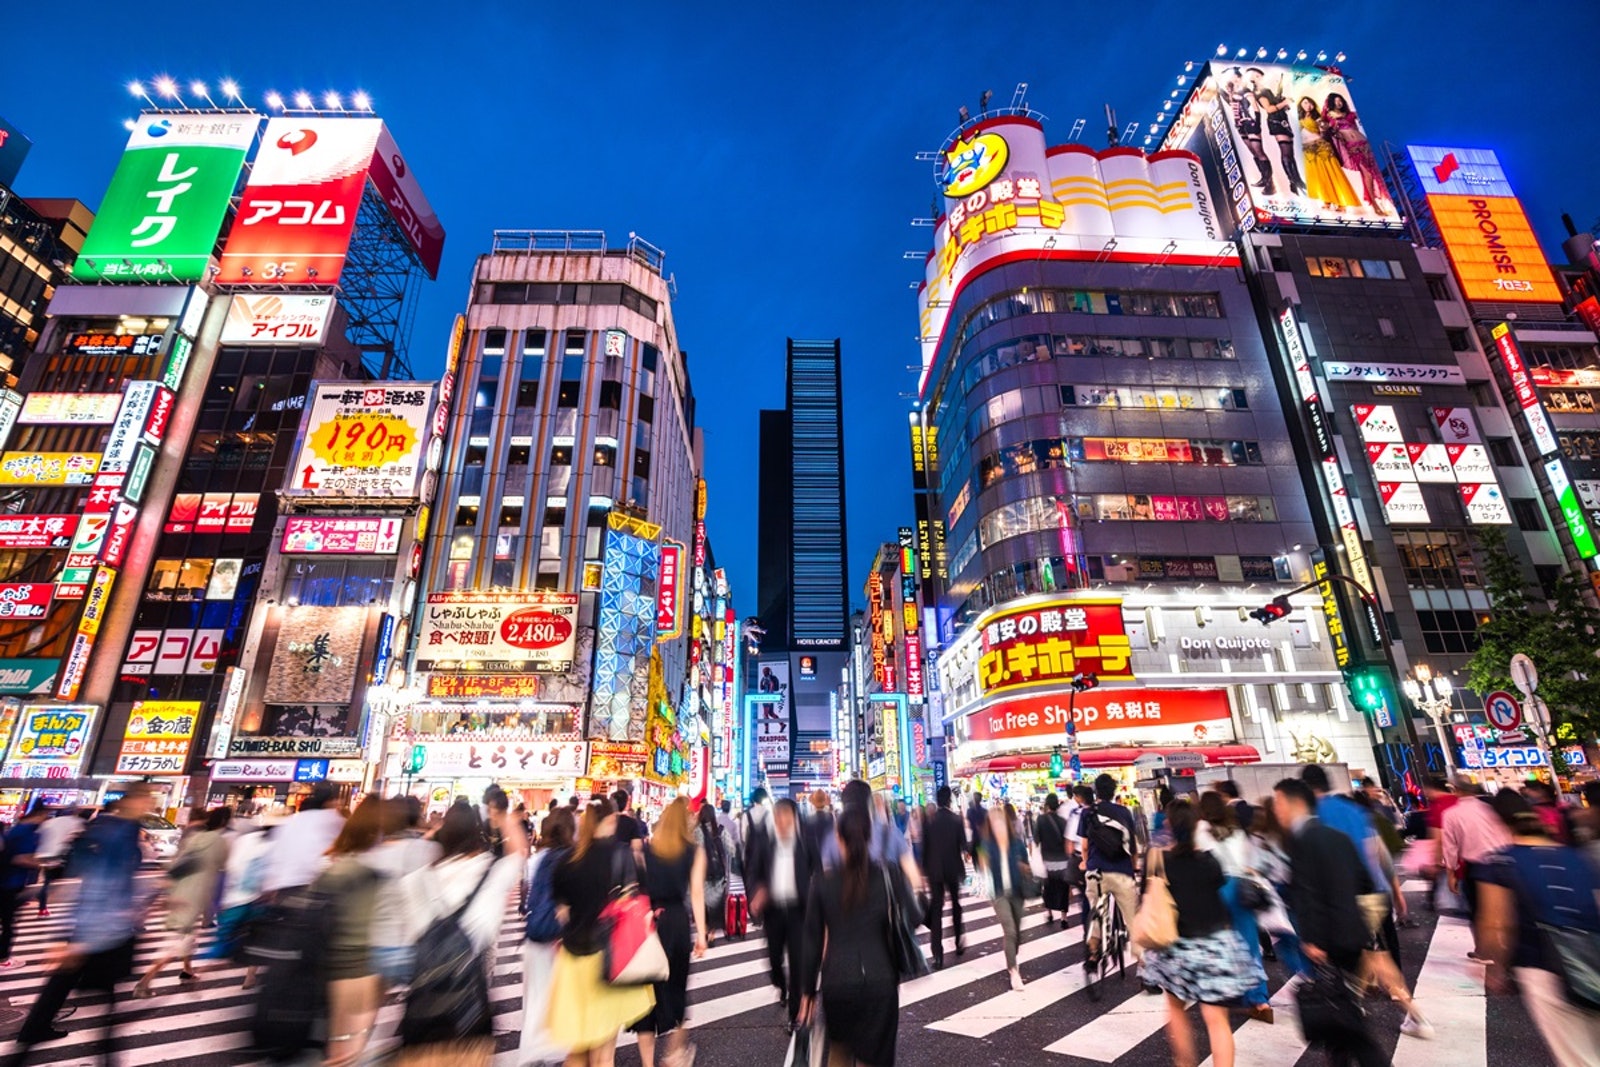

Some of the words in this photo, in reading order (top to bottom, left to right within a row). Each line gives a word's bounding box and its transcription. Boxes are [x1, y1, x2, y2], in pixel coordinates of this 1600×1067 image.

[178, 122, 241, 135] 新生銀行
[131, 153, 198, 247] レイク
[1188, 162, 1200, 187] Don
[1196, 191, 1216, 240] Quijote
[243, 200, 345, 226] アコム
[390, 187, 422, 248] アコム
[1468, 199, 1517, 274] PROMISE
[261, 262, 297, 279] 3F
[1493, 278, 1534, 291] プロミス
[251, 323, 318, 337] アイフル
[1331, 367, 1373, 377] エンタメ
[1377, 367, 1460, 378] レストランタワー
[1377, 385, 1422, 393] SQUARE
[327, 422, 406, 451] 190円
[1369, 445, 1380, 453] 4F
[322, 477, 403, 490] 左の路地を右へ
[1381, 485, 1392, 493] B1
[1462, 486, 1474, 494] 2F
[201, 501, 258, 515] アイフル
[23, 516, 67, 535] 本陣
[380, 542, 395, 550] 1F
[430, 607, 502, 619] しゃぶしゃぶ
[507, 624, 554, 644] 2,480
[988, 608, 1089, 645] 驚安の殿堂
[128, 636, 219, 660] アコム
[726, 623, 735, 668] SHIDAX
[1180, 637, 1214, 650] Don
[1218, 636, 1271, 654] Quijote
[130, 665, 145, 673] 3F
[33, 715, 82, 731] まんが
[146, 716, 193, 734] 金の蔵
[989, 717, 1004, 733] Tax
[1006, 710, 1039, 729] Free
[1045, 704, 1099, 726] Shop
[1105, 702, 1161, 720] 免税店
[128, 756, 181, 770] チカラめし
[468, 744, 566, 769] とらそば
